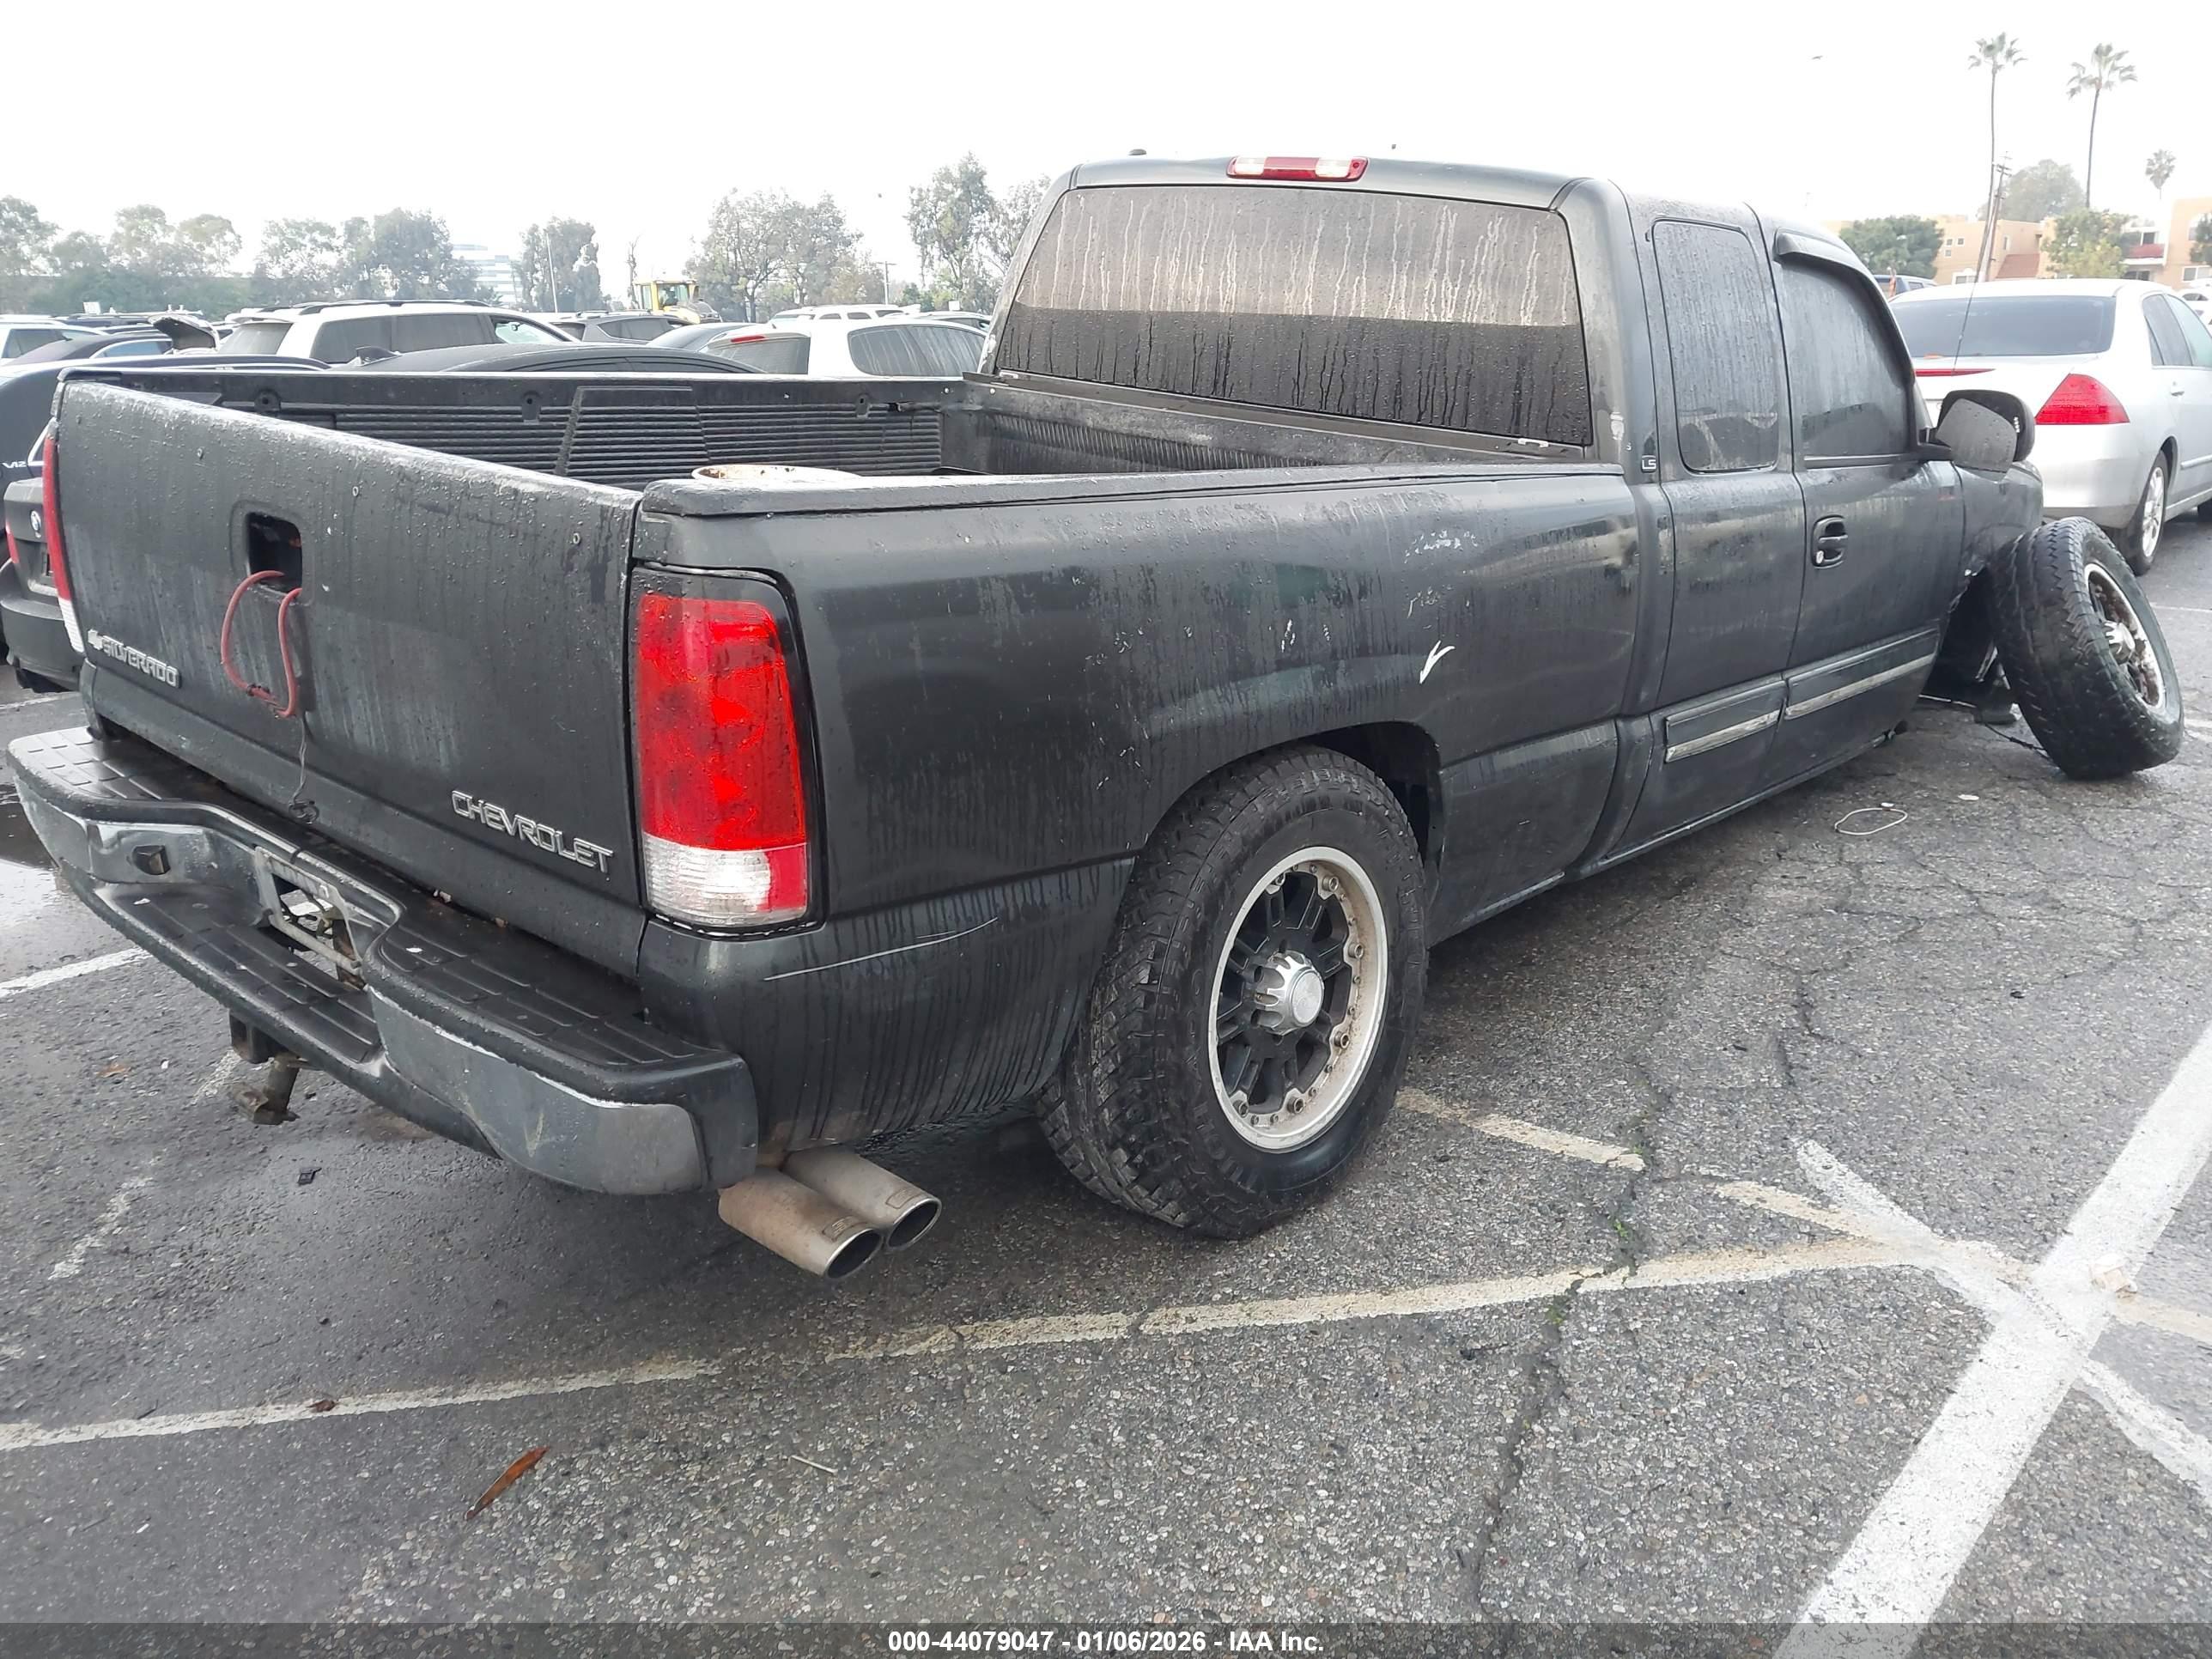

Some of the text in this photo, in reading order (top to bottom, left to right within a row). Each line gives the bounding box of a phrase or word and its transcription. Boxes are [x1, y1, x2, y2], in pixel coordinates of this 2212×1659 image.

[1641, 459, 1656, 470] LS
[102, 635, 178, 688] SILVERADO
[452, 790, 613, 872] CHEVROLET
